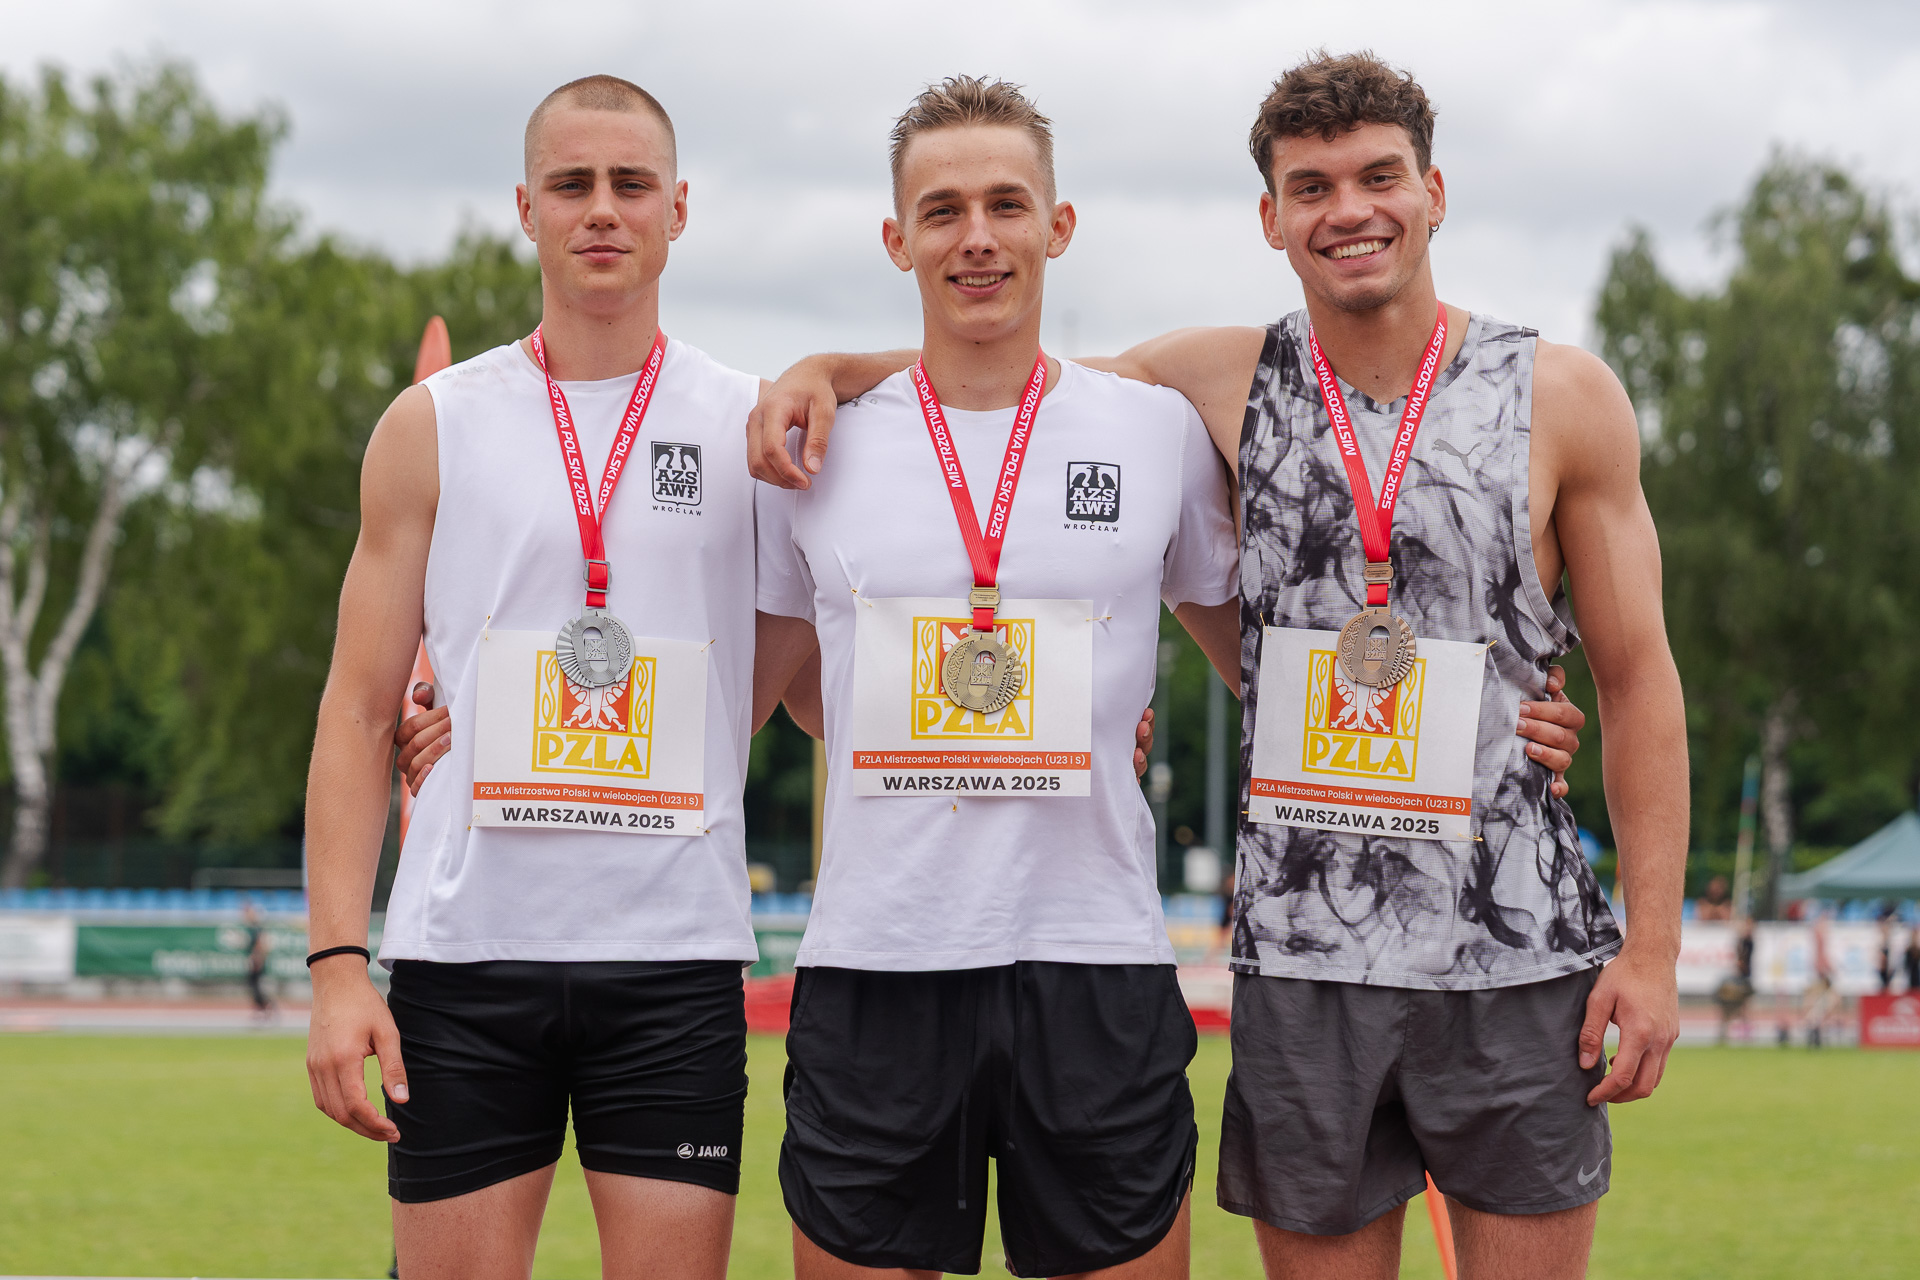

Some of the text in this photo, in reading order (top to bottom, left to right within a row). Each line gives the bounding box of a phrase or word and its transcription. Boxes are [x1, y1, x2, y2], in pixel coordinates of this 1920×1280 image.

[623, 345, 662, 432] MISTRZOSTWA
[1318, 361, 1356, 455] MISTRZOSTWA
[1382, 322, 1444, 509] MISTRZOSTWA POLSKI 2025
[604, 433, 630, 479] POLSKI
[926, 400, 962, 488] MISTRZOSTWA
[990, 363, 1045, 538] MISTRZOSTWA POLSKI 2025
[562, 430, 583, 478] POLSKI
[574, 482, 590, 516] 2025
[656, 469, 697, 484] AZS
[656, 483, 698, 498] AWF
[1070, 488, 1116, 502] AZS
[652, 506, 701, 516] WROCŁAW
[1070, 501, 1115, 516] AWF
[1064, 524, 1118, 532] WROCŁAW
[918, 700, 1026, 734] PZLA
[539, 733, 643, 771] PZLA
[860, 756, 881, 764] PZLA
[884, 755, 940, 764] Mistrzostwa
[943, 755, 970, 764] Polski
[982, 755, 1042, 766] wielobojach
[1045, 756, 1068, 766] (U23
[1075, 756, 1086, 766] S)
[1308, 733, 1409, 774] PZLA
[480, 786, 502, 795] PZLA
[504, 787, 560, 797] Mistrzostwa
[563, 788, 590, 798] Polski
[602, 790, 658, 804] wielobojach
[660, 793, 682, 806] (U23
[688, 795, 698, 806] S)
[883, 776, 1060, 791] WARSZAWA 2025
[1256, 783, 1276, 792] PZLA
[1277, 785, 1326, 798] Mistrzostwa
[1328, 789, 1353, 801] Polski
[1364, 793, 1422, 807] wielobojach
[1425, 798, 1448, 810] (U23
[1455, 800, 1465, 811] S)
[502, 808, 675, 829] WARSZAWA 2025
[1275, 806, 1440, 834] WARSZAWA 2025
[698, 1146, 728, 1157] JAKO
